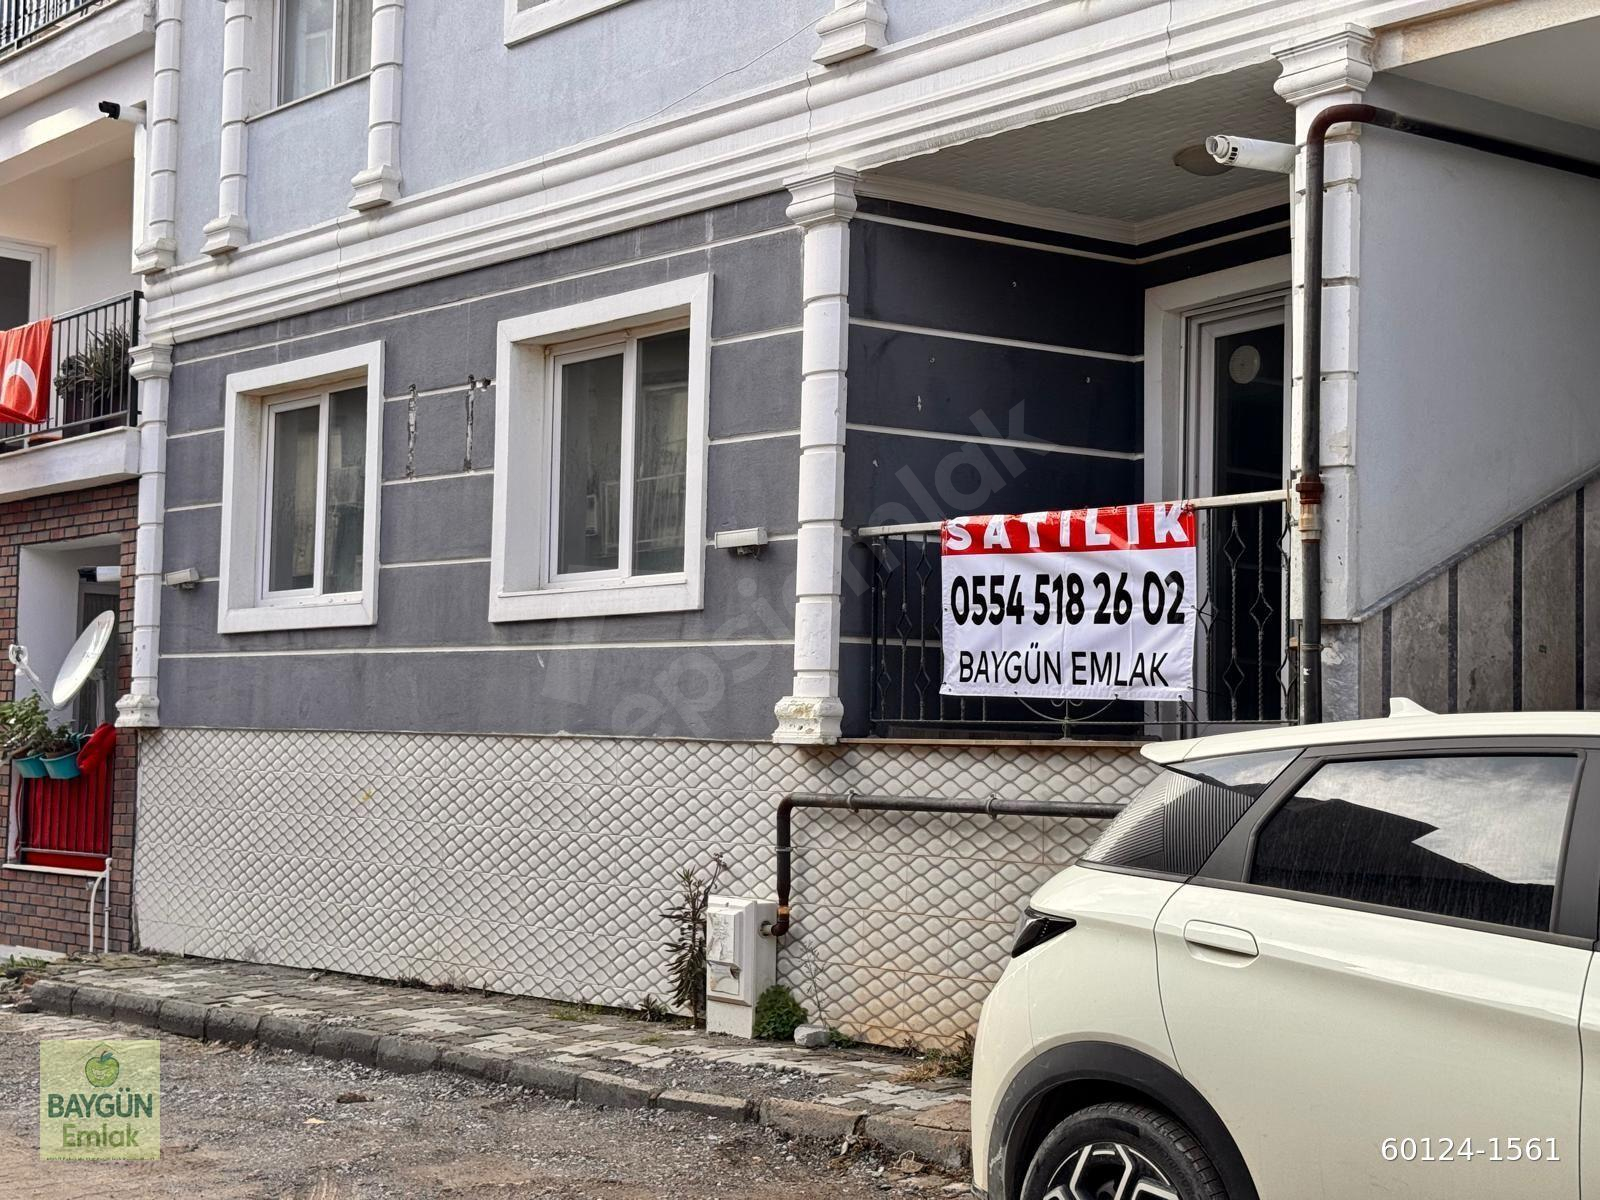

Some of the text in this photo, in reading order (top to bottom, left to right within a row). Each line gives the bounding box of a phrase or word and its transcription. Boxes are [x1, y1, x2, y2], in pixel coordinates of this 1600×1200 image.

[945, 502, 1189, 551] SATILIK
[950, 570, 1186, 626] 0554 518 26 02
[958, 641, 1169, 687] BAYGÜN EMLAK
